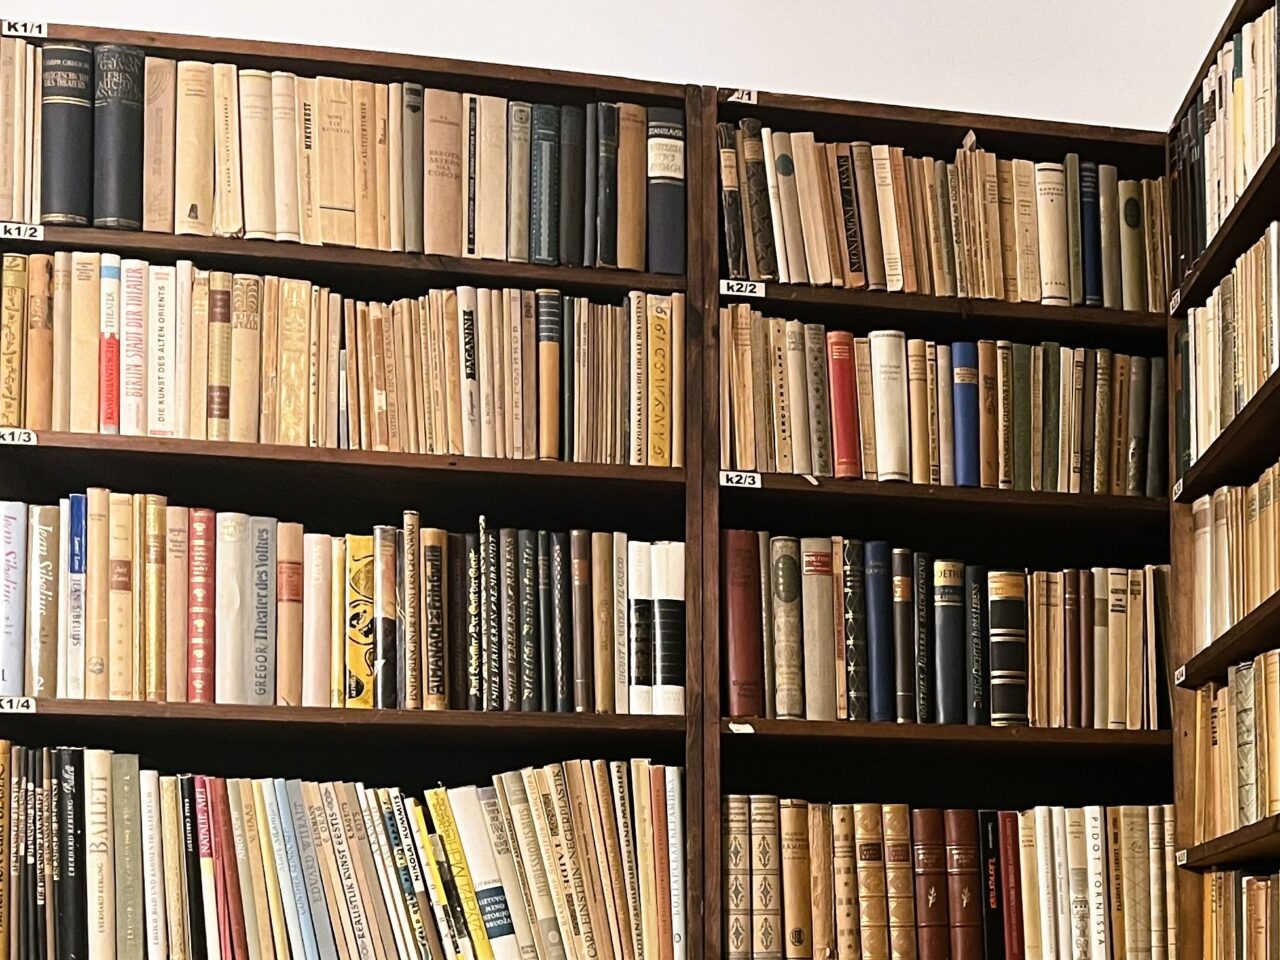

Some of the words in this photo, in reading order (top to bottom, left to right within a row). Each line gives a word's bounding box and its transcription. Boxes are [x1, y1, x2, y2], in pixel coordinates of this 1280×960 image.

[6, 21, 43, 34] K1/1
[303, 102, 312, 150] MINEVIKUST
[3, 225, 39, 239] k1/2
[158, 285, 166, 324] ORIENTS
[726, 281, 758, 294] k2/2
[158, 325, 166, 353] ALTEN
[655, 305, 668, 342] 1919
[464, 312, 476, 376] PAGANINI
[157, 375, 165, 405] KUNST
[157, 406, 165, 422] DIE
[725, 474, 757, 486] k2/3
[199, 812, 210, 854] NATALIE
[392, 794, 409, 840] KUMMITS
[1091, 816, 1101, 862] PIDOT
[406, 843, 420, 882] NIKOLAI
[1094, 871, 1105, 946] TORNISSA
